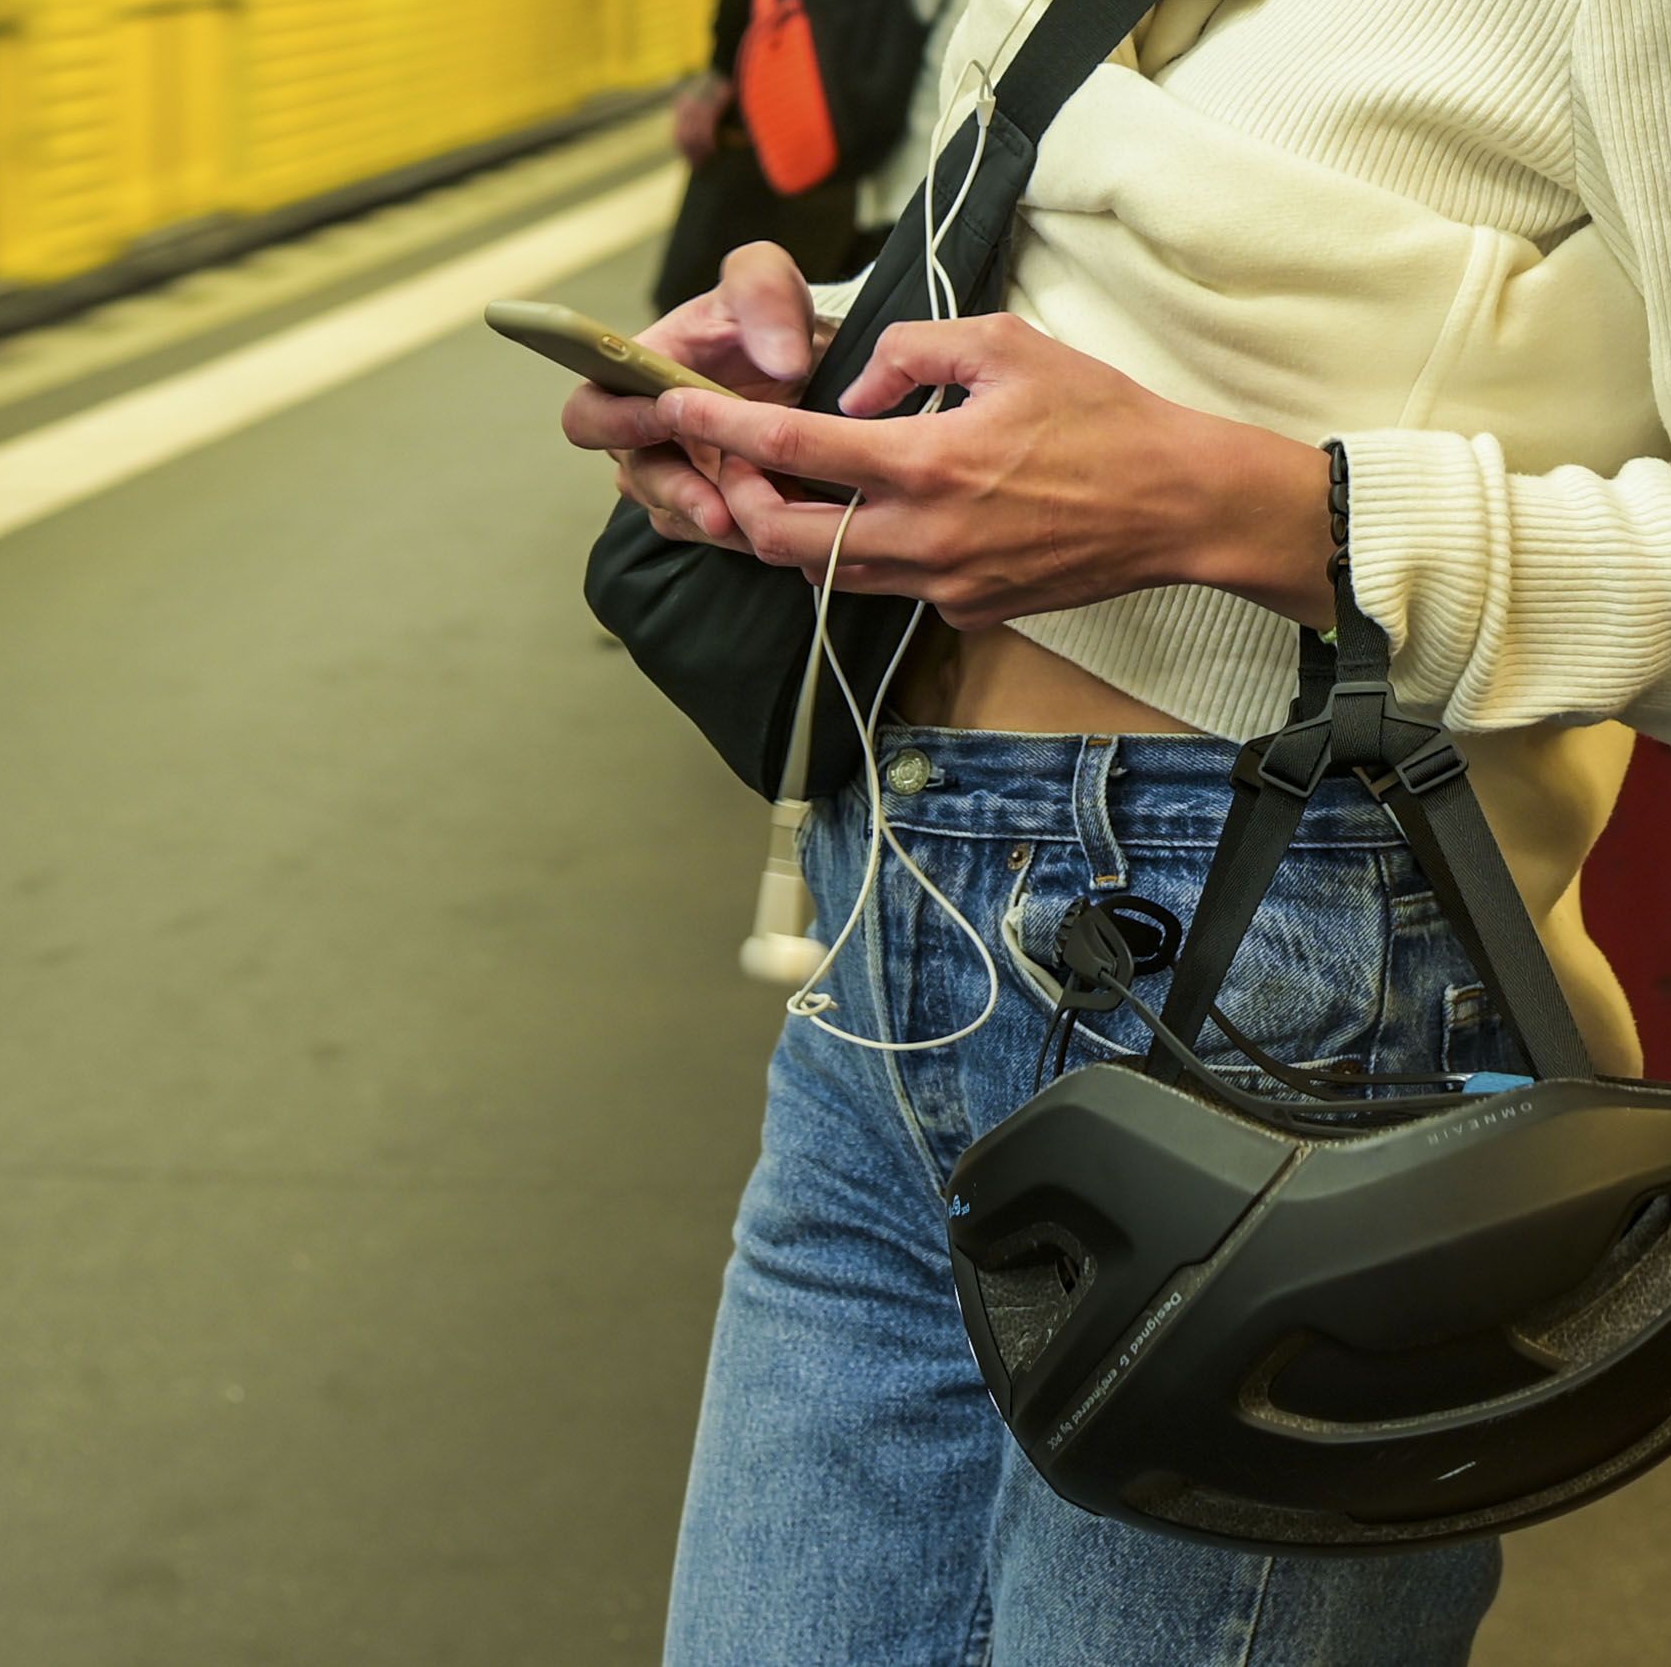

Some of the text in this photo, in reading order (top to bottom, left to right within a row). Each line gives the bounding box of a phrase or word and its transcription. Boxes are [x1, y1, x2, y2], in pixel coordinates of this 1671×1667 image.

[1130, 1291, 1183, 1355] Designed
[1119, 1354, 1130, 1368] &
[1071, 1367, 1118, 1425] engineered
[1060, 1421, 1074, 1435] by
